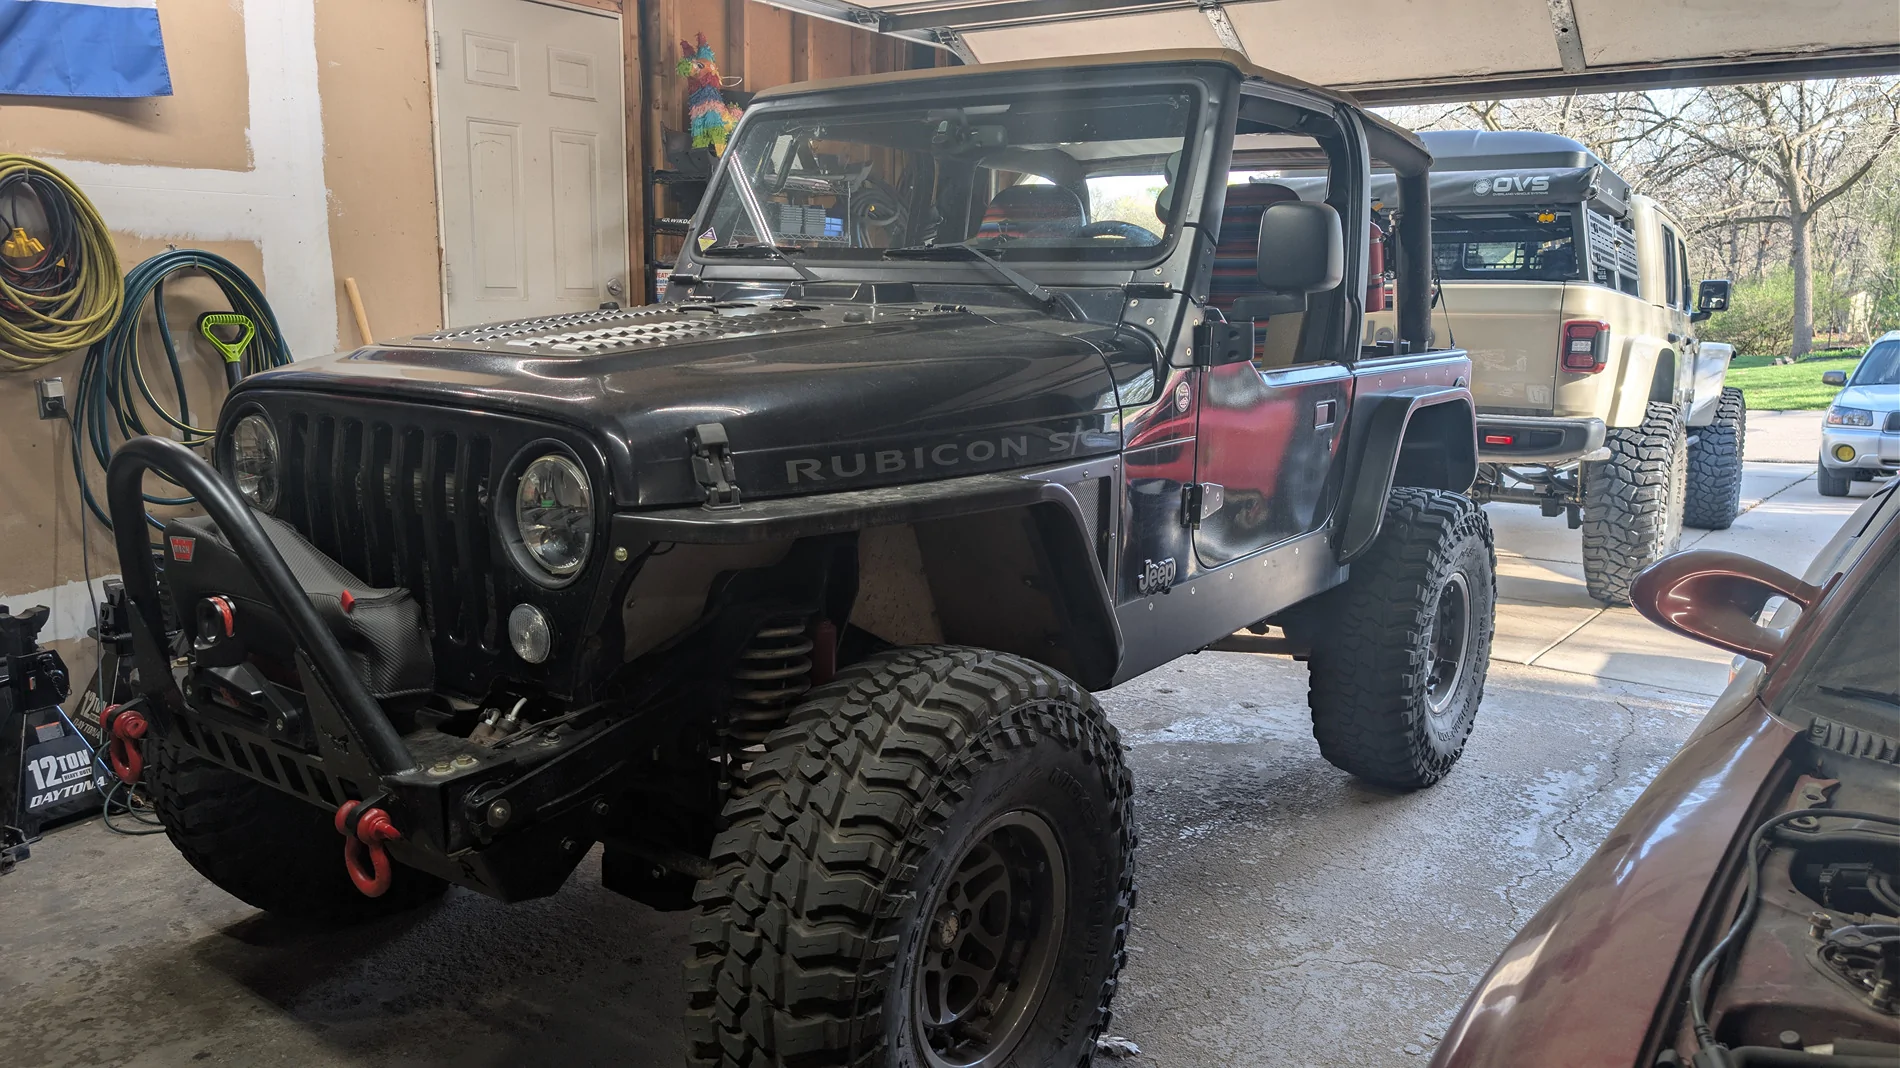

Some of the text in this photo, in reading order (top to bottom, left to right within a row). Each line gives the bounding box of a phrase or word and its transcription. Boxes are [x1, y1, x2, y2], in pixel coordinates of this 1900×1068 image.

[1493, 176, 1550, 192] OVS
[785, 436, 1028, 483] RUBICON
[1138, 557, 1176, 591] Jeep
[80, 690, 97, 719] 12
[27, 749, 91, 791] 12 TON
[63, 772, 79, 781] HEAVY
[29, 776, 108, 809] DAYTONA
